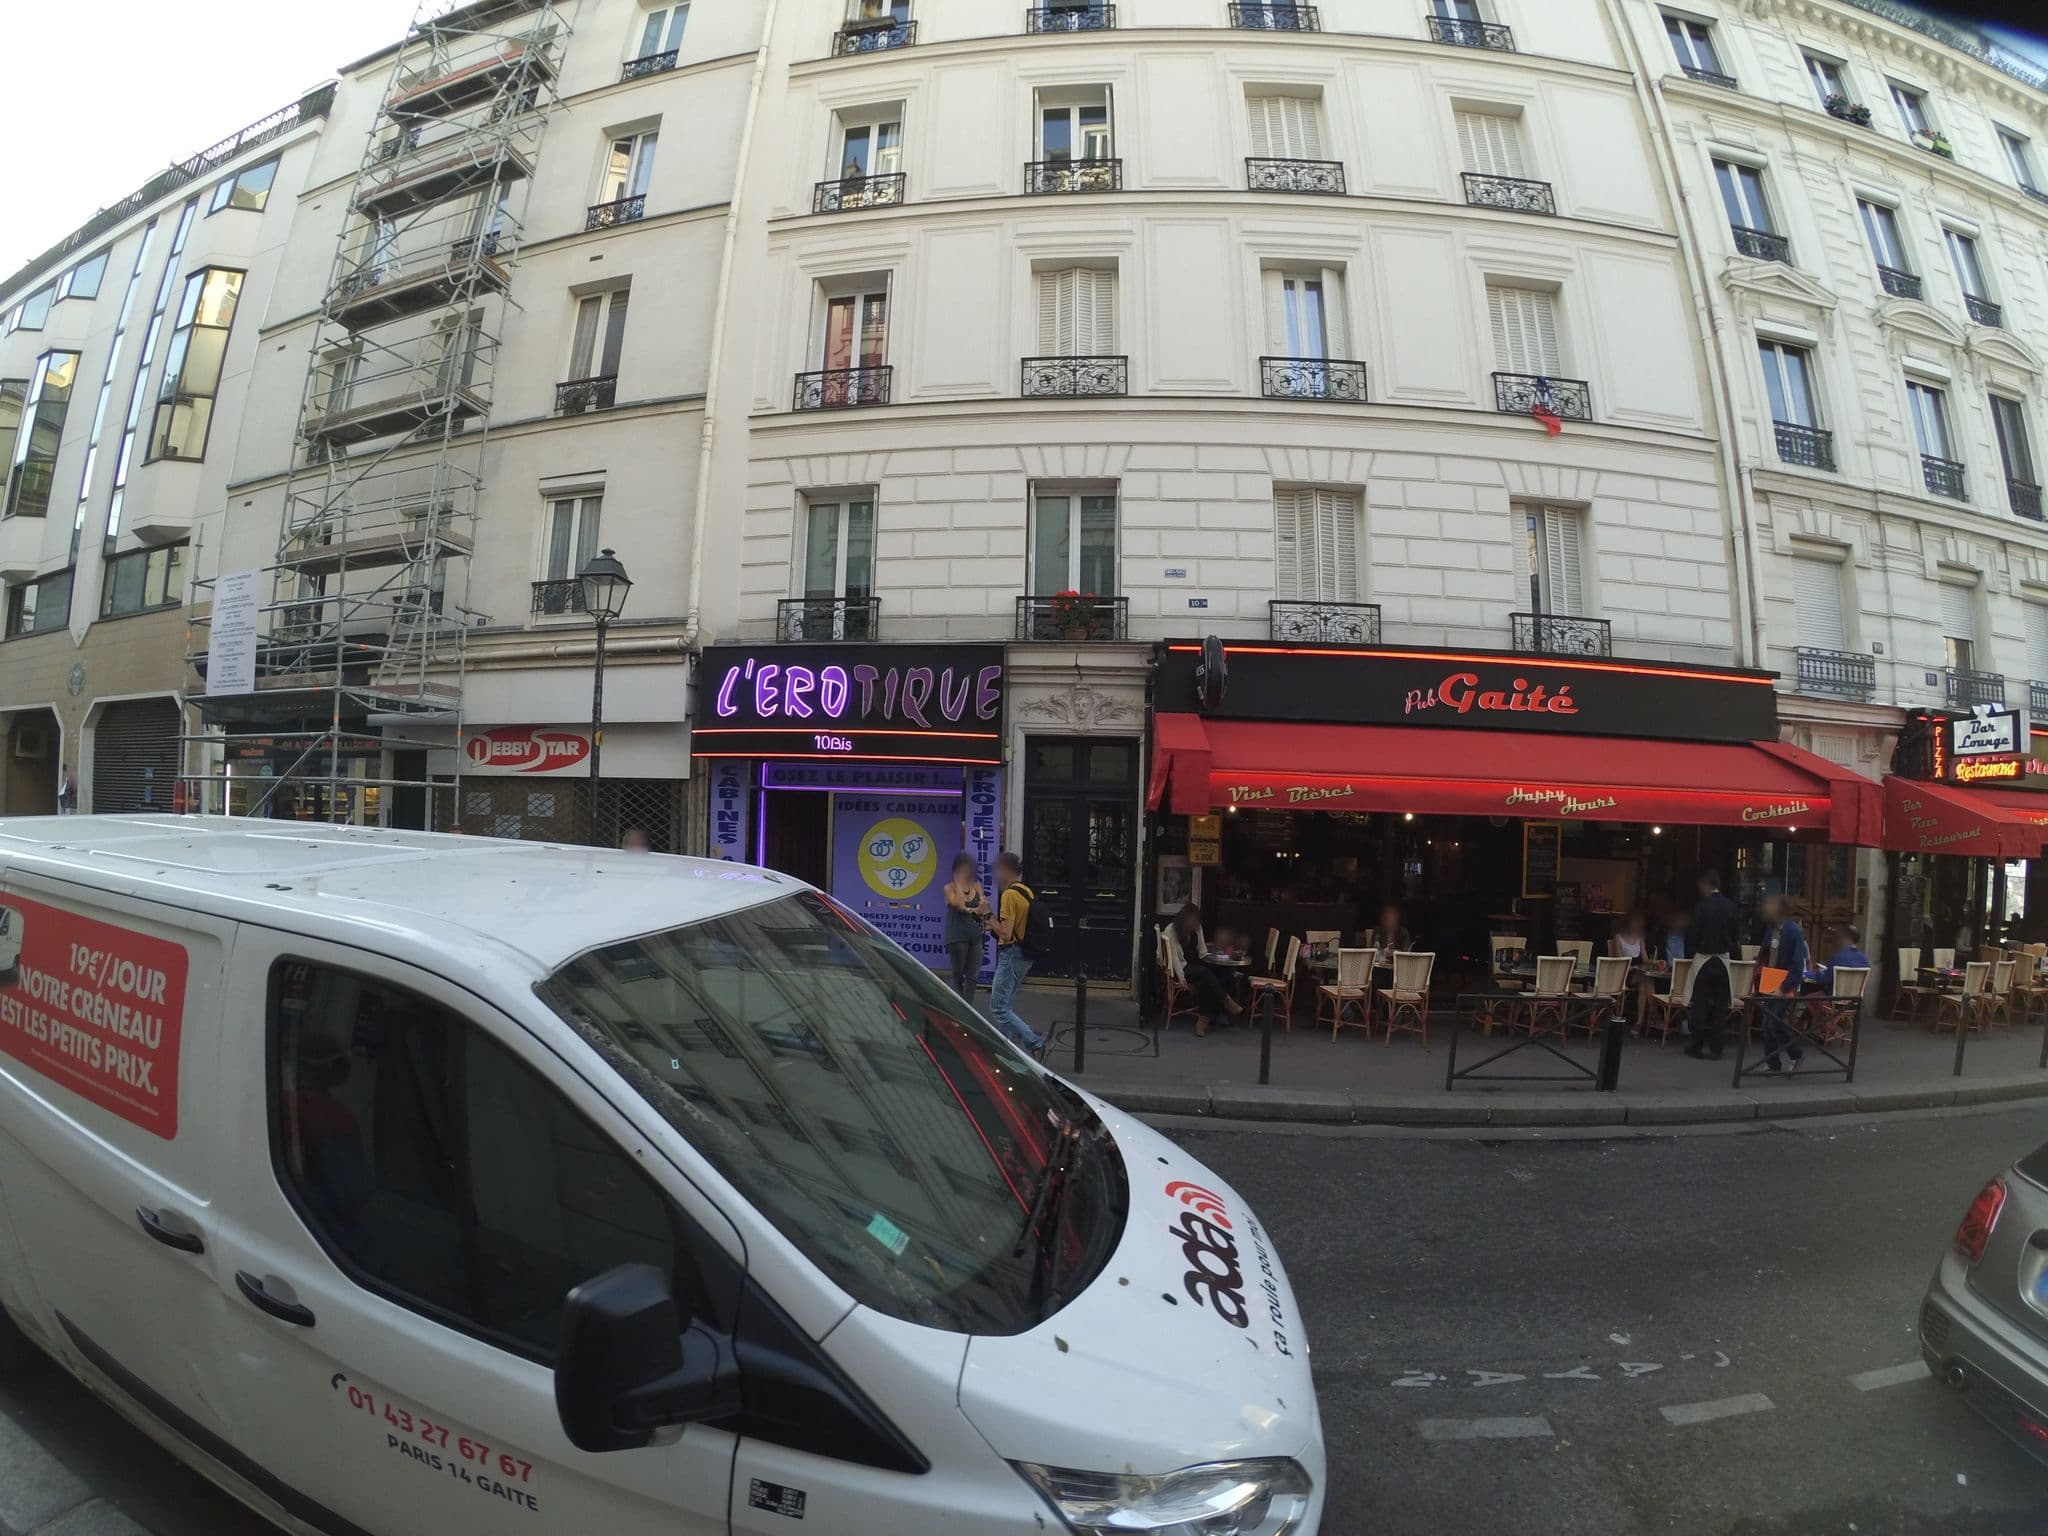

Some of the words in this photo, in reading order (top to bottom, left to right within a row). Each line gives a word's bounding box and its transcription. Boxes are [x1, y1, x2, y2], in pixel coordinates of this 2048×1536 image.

[717, 658, 1001, 728] L'EROTIQUE
[1405, 688, 1438, 714] Pub
[1438, 673, 1580, 714] Gaité
[1970, 720, 1996, 735] Bar
[814, 735, 852, 750] 10Bis
[1934, 726, 1943, 778] PIZZA
[1957, 734, 2010, 750] Lounge
[774, 768, 817, 783] OSEZ
[826, 769, 844, 783] LE
[852, 769, 926, 785] PLAISIR
[718, 766, 739, 844] CABINES
[1228, 786, 1275, 802] Vins
[1286, 784, 1355, 803] Bières
[1506, 787, 1567, 805] Happy
[1560, 796, 1617, 815] Hours
[1902, 800, 1922, 813] Bar
[886, 801, 961, 815] CADEAUX
[1742, 800, 1809, 822] Cocktails
[1920, 826, 1985, 848] Restaurant
[892, 914, 917, 922] POUR
[920, 915, 942, 923] TOUS
[901, 922, 922, 930] TOYS
[18, 964, 70, 1012] NOTRE
[72, 987, 162, 1049] CRÉNEAU
[24, 1006, 48, 1042] LES
[51, 1018, 101, 1069] PETITS
[105, 1044, 159, 1097] PRIX.
[1169, 1212, 1249, 1328] ada
[1254, 1242, 1279, 1283] pour
[1260, 1280, 1285, 1328] roule
[1274, 1331, 1294, 1359] ça
[348, 1386, 375, 1416] 01
[384, 1403, 414, 1433] 43
[419, 1418, 450, 1449] 27
[458, 1437, 490, 1465] 67
[499, 1454, 533, 1482] 67
[387, 1433, 442, 1470] PARIS
[448, 1462, 471, 1484] 14
[476, 1475, 539, 1511] GAITE
